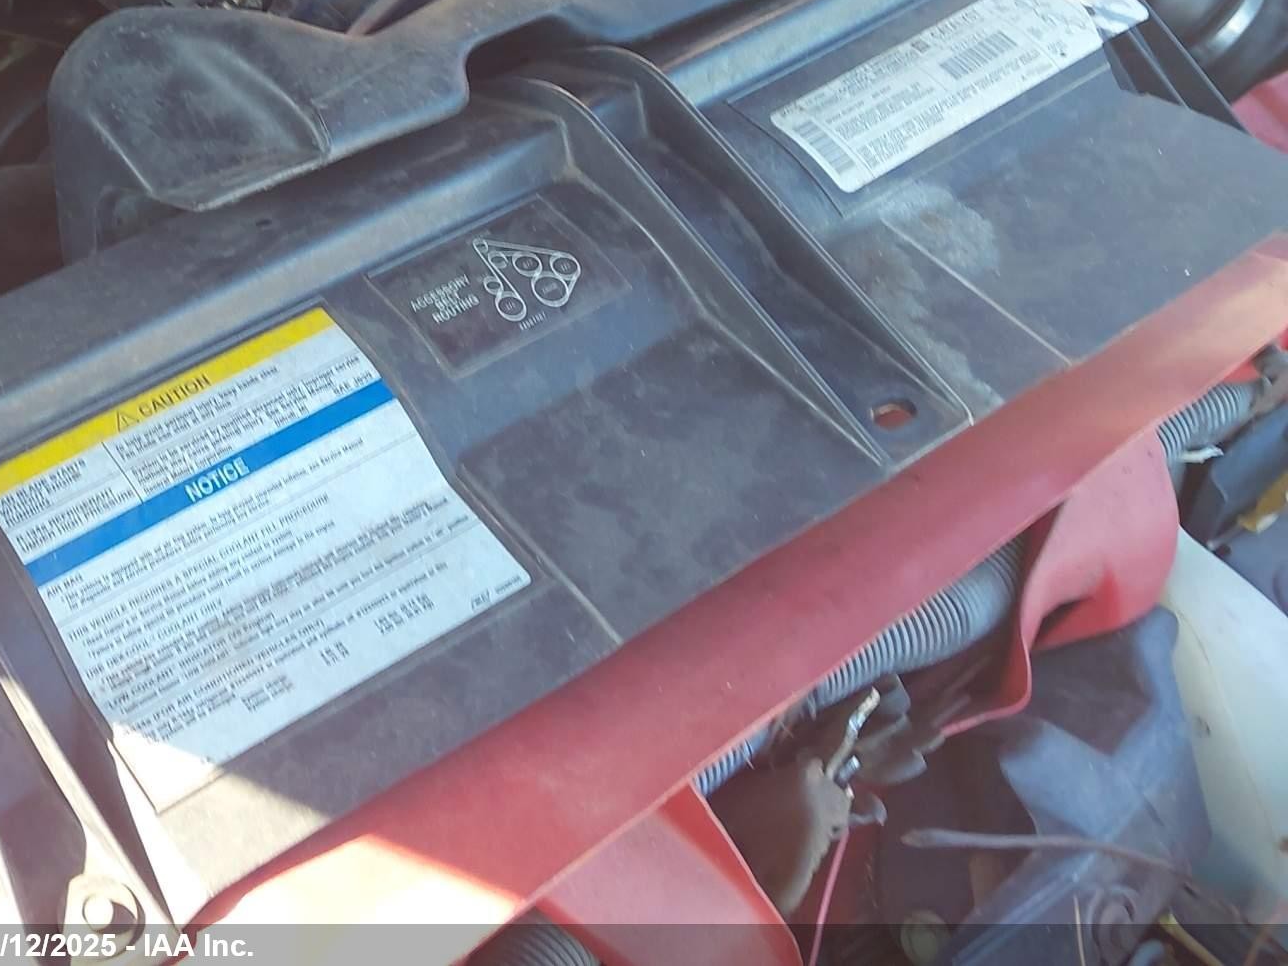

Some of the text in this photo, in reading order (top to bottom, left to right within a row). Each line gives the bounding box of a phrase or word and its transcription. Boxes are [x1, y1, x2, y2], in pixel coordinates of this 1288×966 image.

[410, 273, 472, 312] ACCESSORY
[431, 293, 480, 324] ROUTING
[434, 290, 463, 312] BELT
[138, 373, 209, 417] CAUTION
[185, 457, 249, 500] NOTICE
